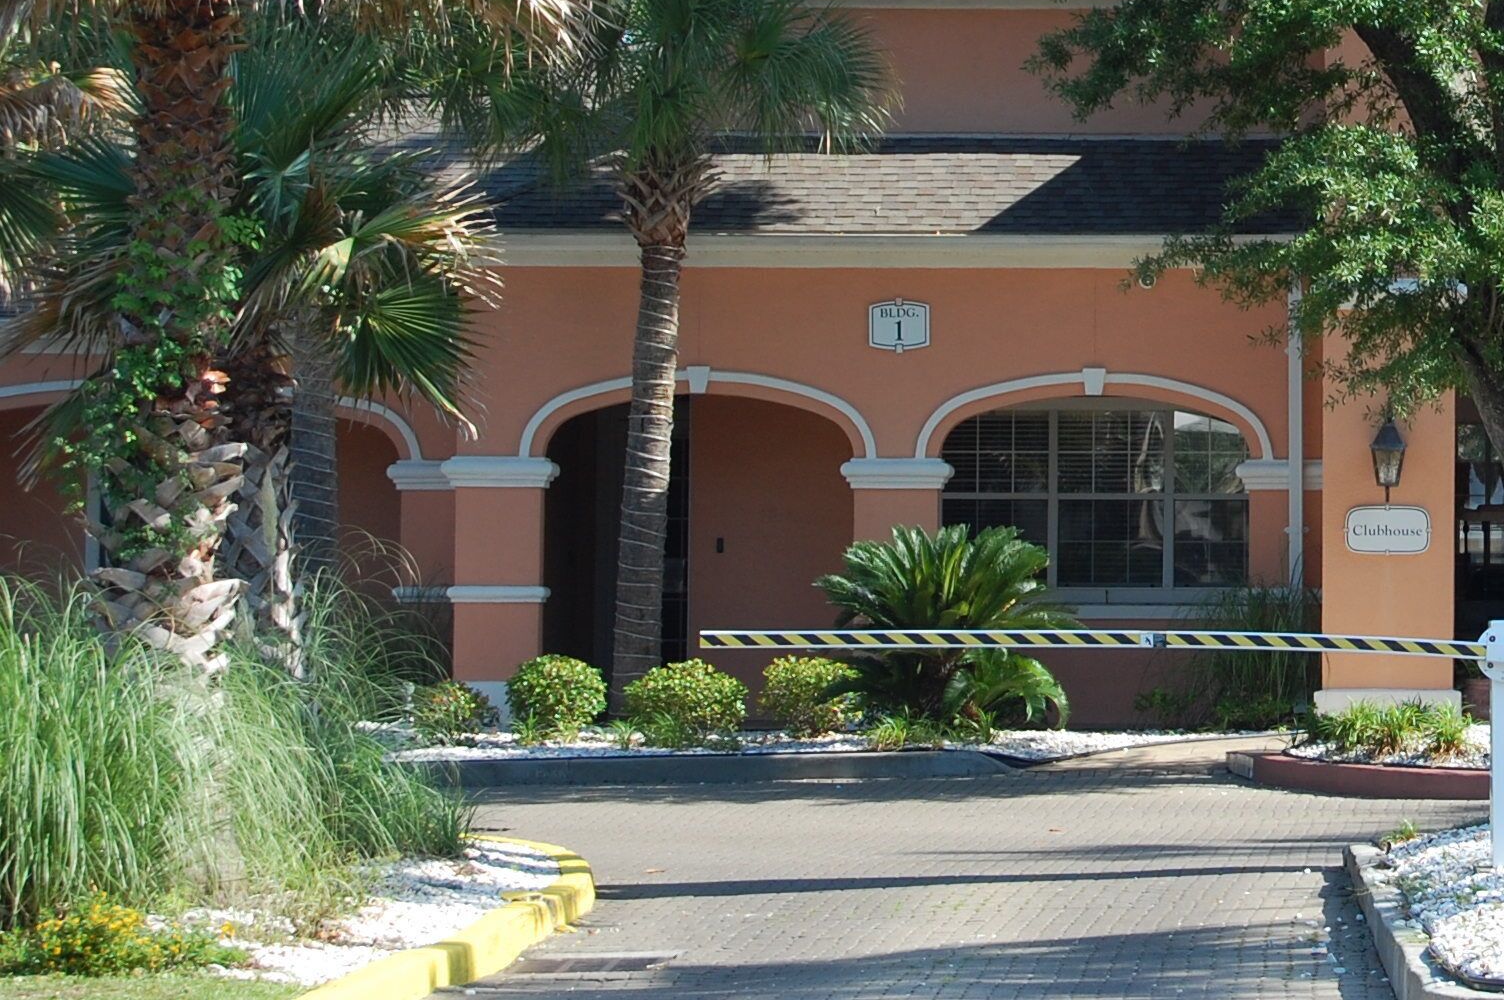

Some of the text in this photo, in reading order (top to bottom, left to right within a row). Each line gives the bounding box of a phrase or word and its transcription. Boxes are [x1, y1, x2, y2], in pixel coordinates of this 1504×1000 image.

[880, 307, 920, 318] BLDG.
[894, 319, 904, 341] 1
[1352, 523, 1424, 537] Clubhouse
